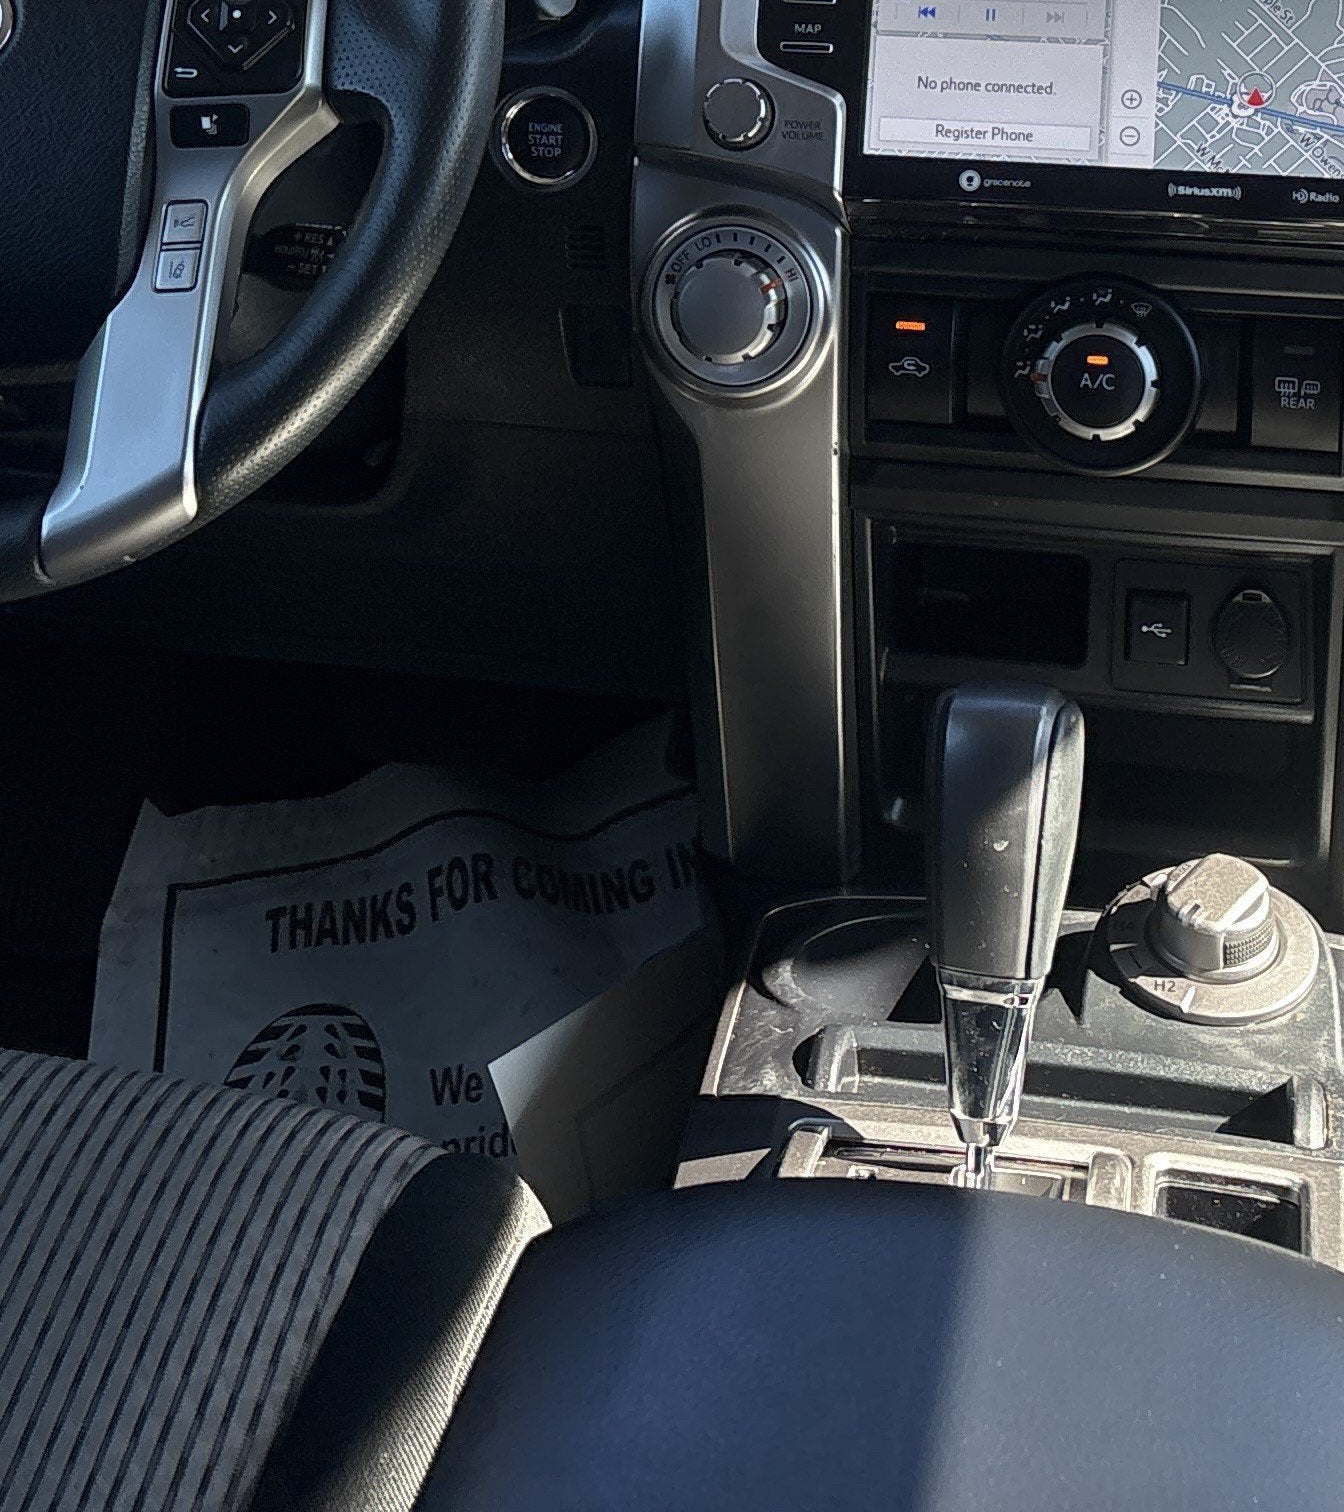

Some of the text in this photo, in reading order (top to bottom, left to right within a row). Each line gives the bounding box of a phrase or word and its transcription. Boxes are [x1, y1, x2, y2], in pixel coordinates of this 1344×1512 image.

[1279, 8, 1295, 24] St
[794, 23, 822, 34] MAP
[917, 75, 1057, 96] No phone connected.
[528, 122, 563, 133] ENGINE
[784, 119, 822, 131] POWER
[527, 134, 563, 146] START
[781, 130, 824, 141] VOLUME
[935, 123, 1034, 143] Register Phone
[1299, 131, 1316, 147] W
[531, 147, 562, 158] STOP
[1309, 191, 1340, 203] Radio
[695, 236, 711, 252] LO
[670, 249, 690, 272] OFF
[784, 268, 799, 283] HI
[1079, 372, 1117, 391] A/C
[1280, 397, 1316, 410] REAR
[265, 881, 417, 954] THANKS
[427, 852, 498, 922] FOR
[510, 855, 656, 916] COMING
[1153, 979, 1176, 993] H2
[429, 1063, 483, 1107] We
